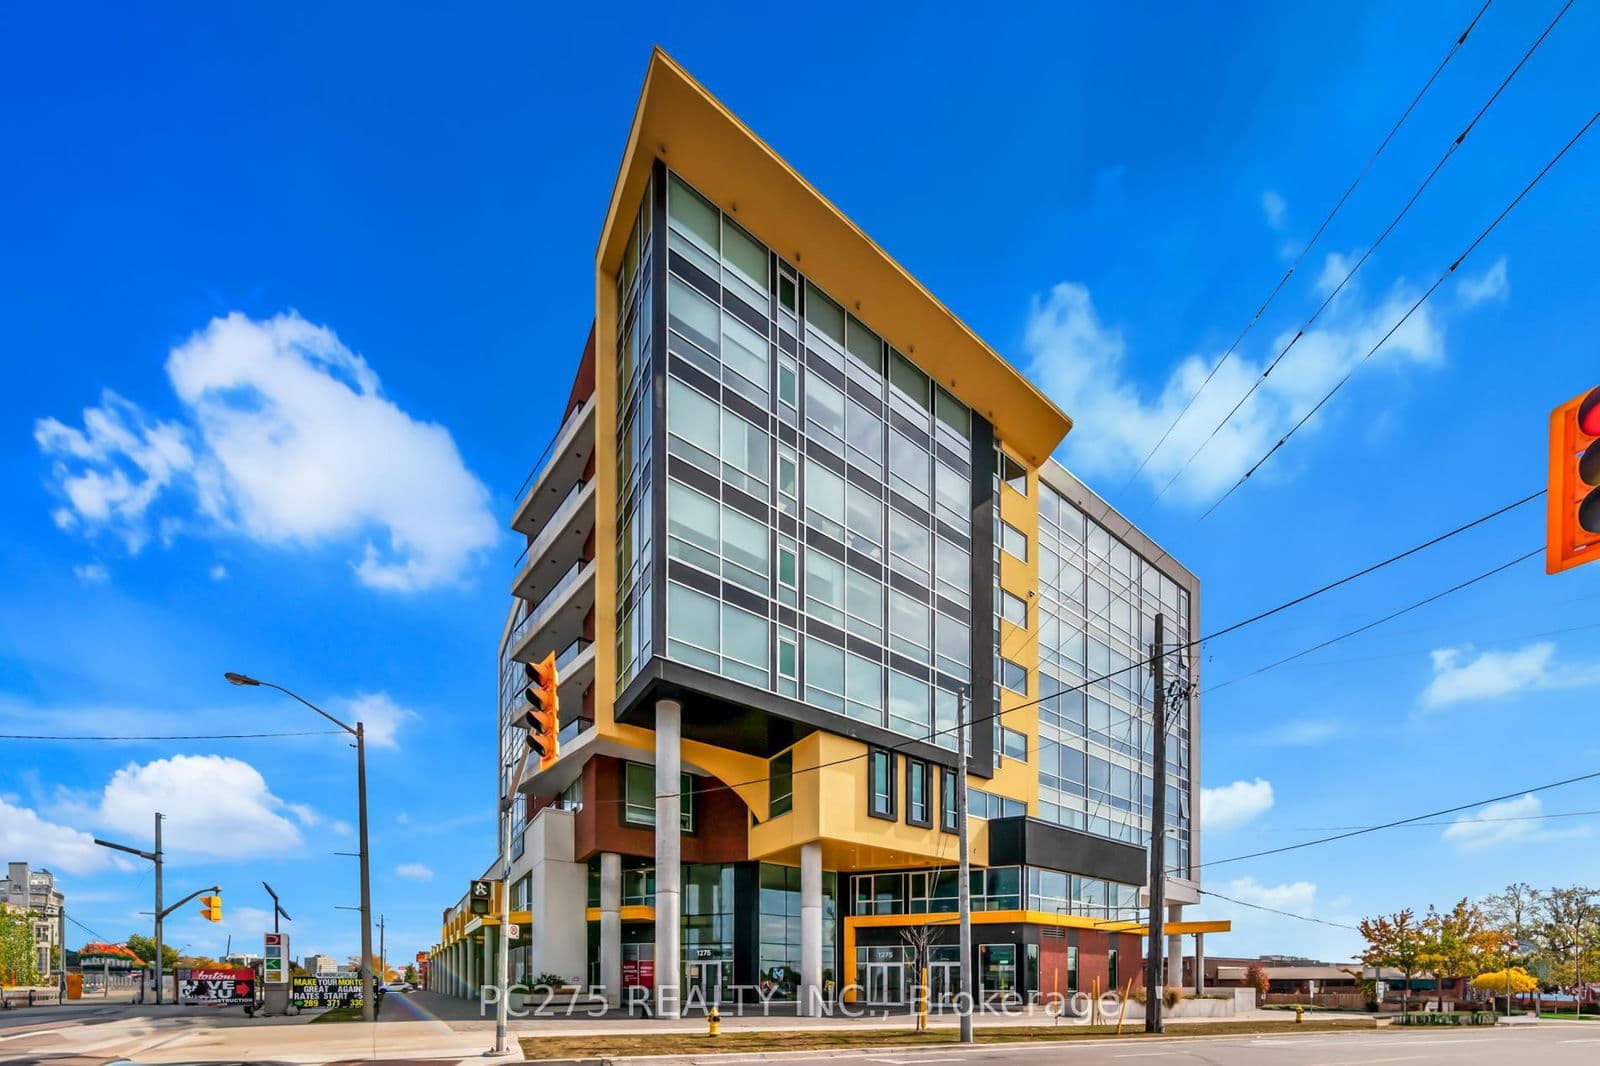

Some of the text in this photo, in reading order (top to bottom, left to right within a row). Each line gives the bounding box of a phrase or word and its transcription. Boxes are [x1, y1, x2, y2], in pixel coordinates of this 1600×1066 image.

[696, 949, 712, 957] 1275
[294, 978, 317, 986] MAKE
[304, 999, 319, 1007] 289
[327, 999, 340, 1008] 371
